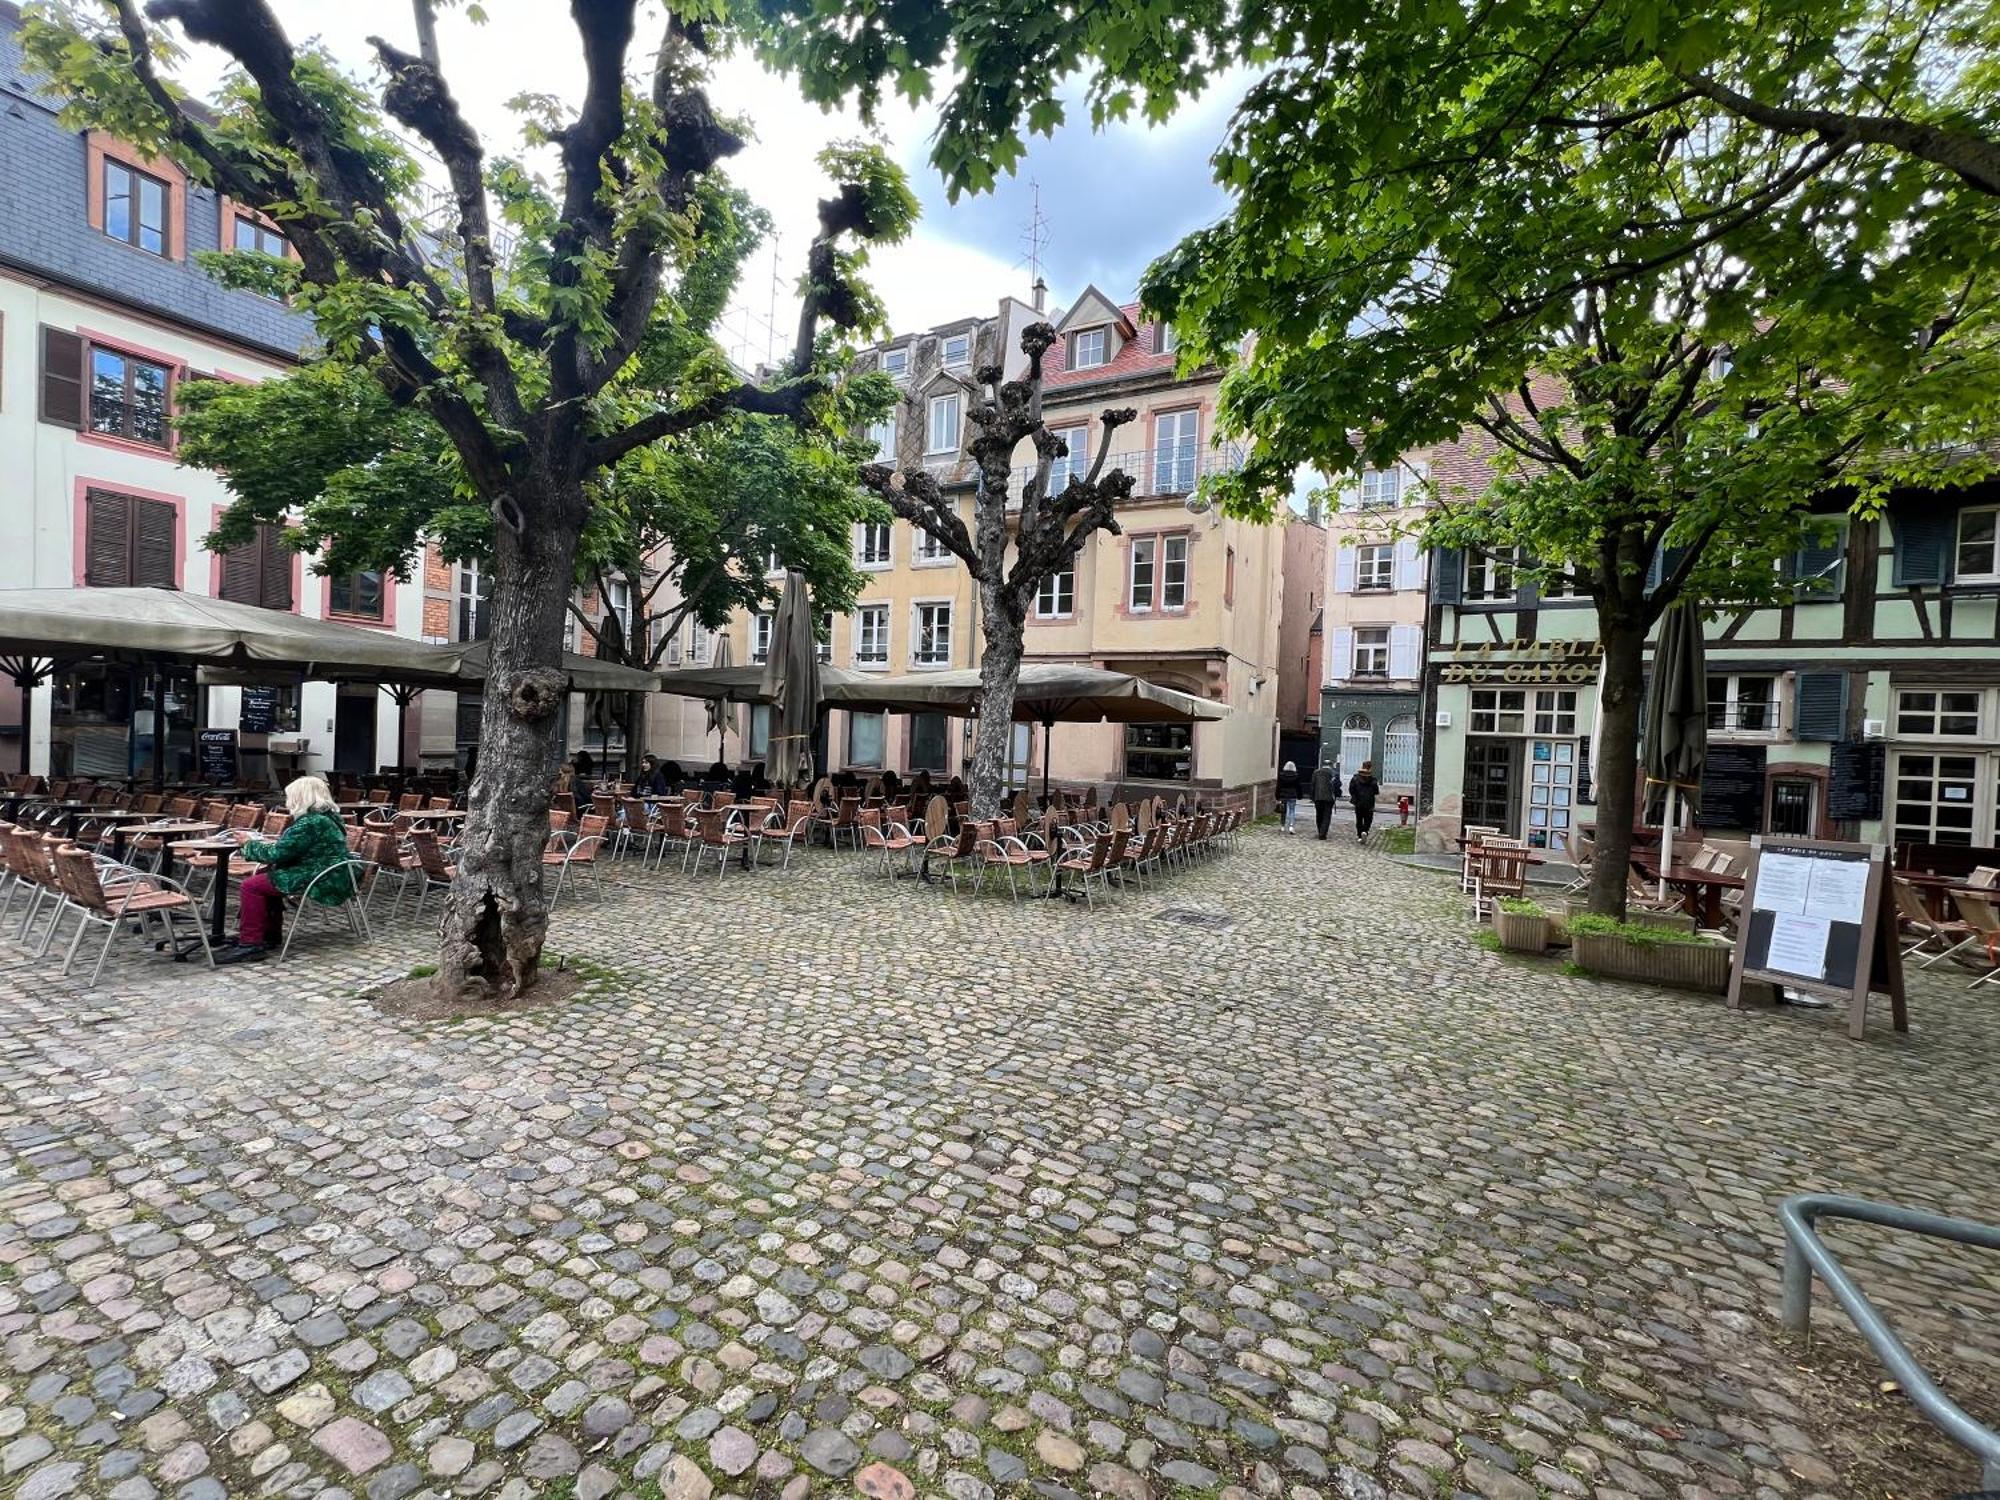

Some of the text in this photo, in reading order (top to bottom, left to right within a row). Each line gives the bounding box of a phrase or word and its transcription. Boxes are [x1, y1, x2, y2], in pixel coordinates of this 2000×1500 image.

[1452, 638, 1604, 657] LA TABLE
[1445, 664, 1492, 683] DU
